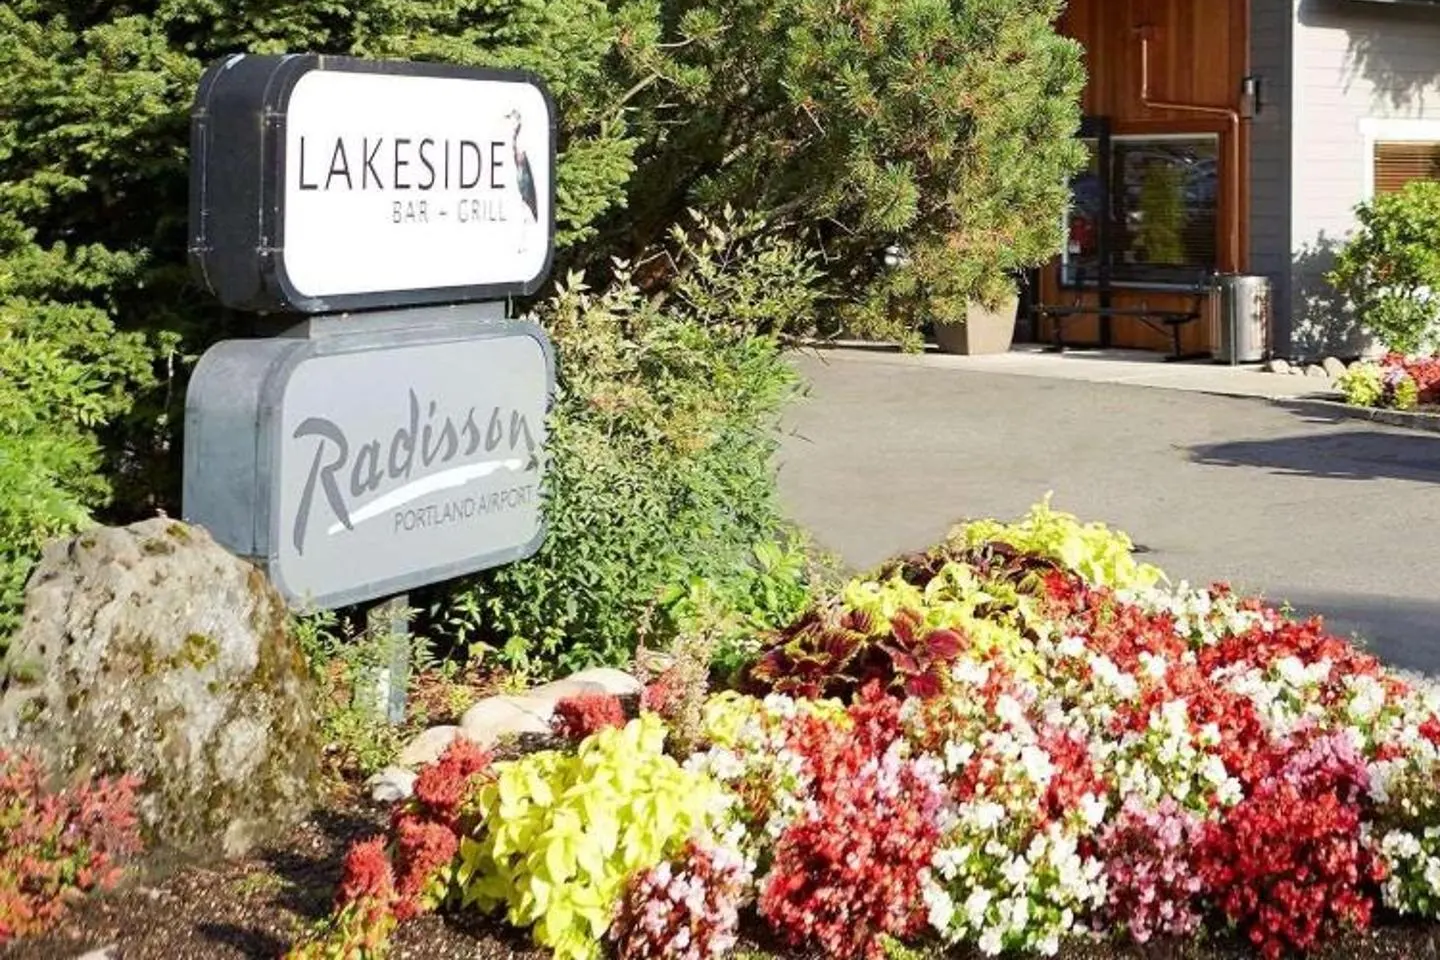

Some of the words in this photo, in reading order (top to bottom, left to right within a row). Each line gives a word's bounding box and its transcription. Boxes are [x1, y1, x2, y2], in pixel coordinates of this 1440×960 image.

[298, 136, 507, 191] LAKESIDE
[392, 200, 429, 224] BAR
[458, 198, 507, 224] GRILL
[292, 386, 540, 557] Radisson
[394, 497, 475, 533] PORTLAND
[477, 485, 533, 515] AIRPORT
